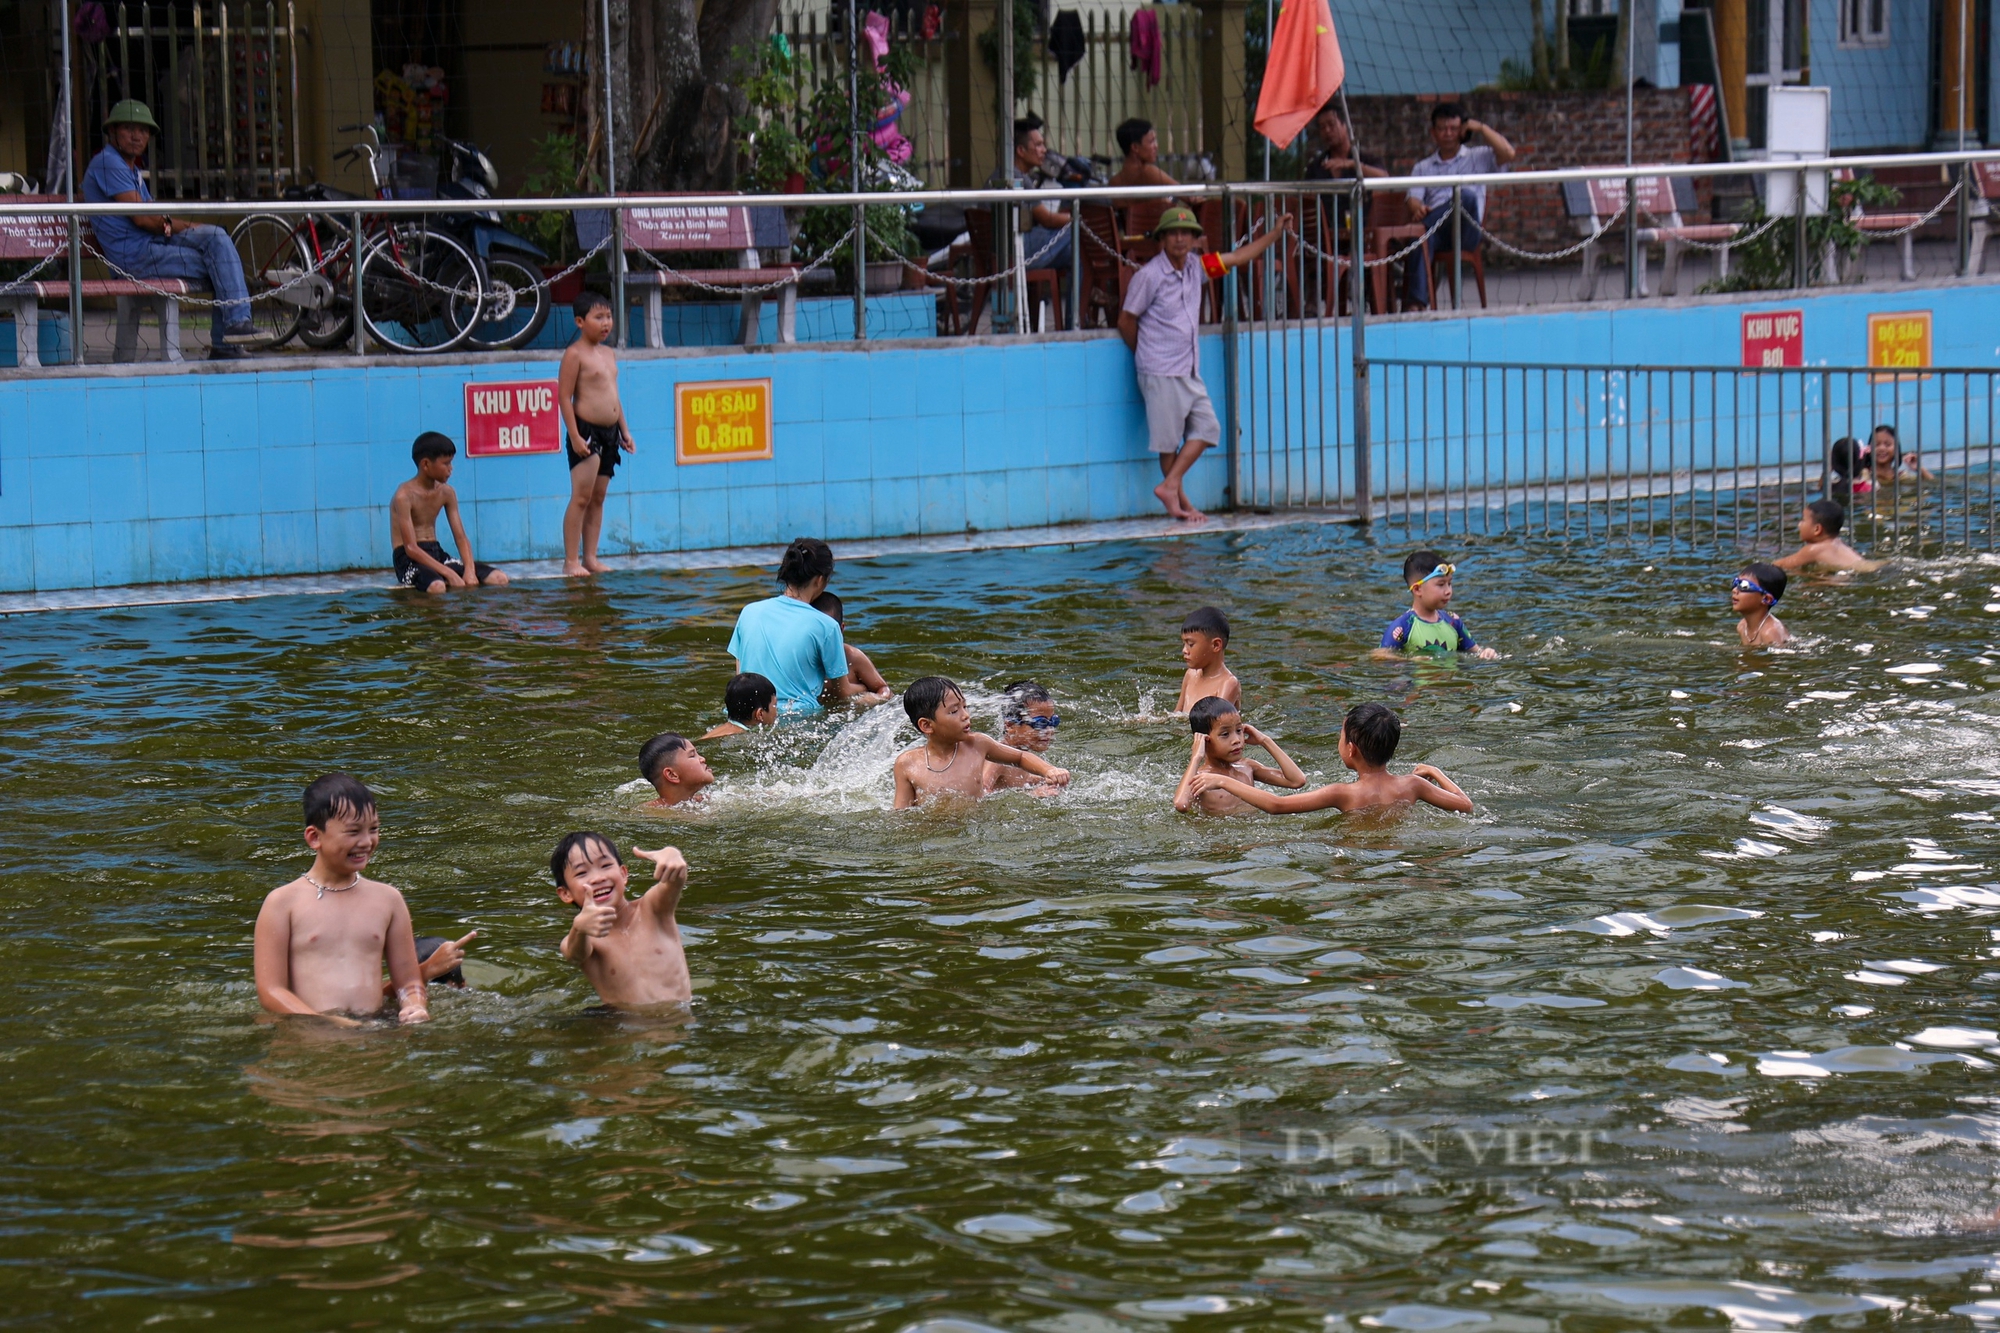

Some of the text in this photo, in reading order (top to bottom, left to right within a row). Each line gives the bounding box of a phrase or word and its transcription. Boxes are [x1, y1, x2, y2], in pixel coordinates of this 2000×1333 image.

[1747, 314, 1800, 342] KHU VỰC
[1762, 347, 1784, 368] BƠI
[473, 386, 553, 417] KHU VỰC
[691, 391, 758, 415] ĐỘ SÂU
[498, 425, 531, 450] BƠI
[695, 423, 754, 452] 0,8m
